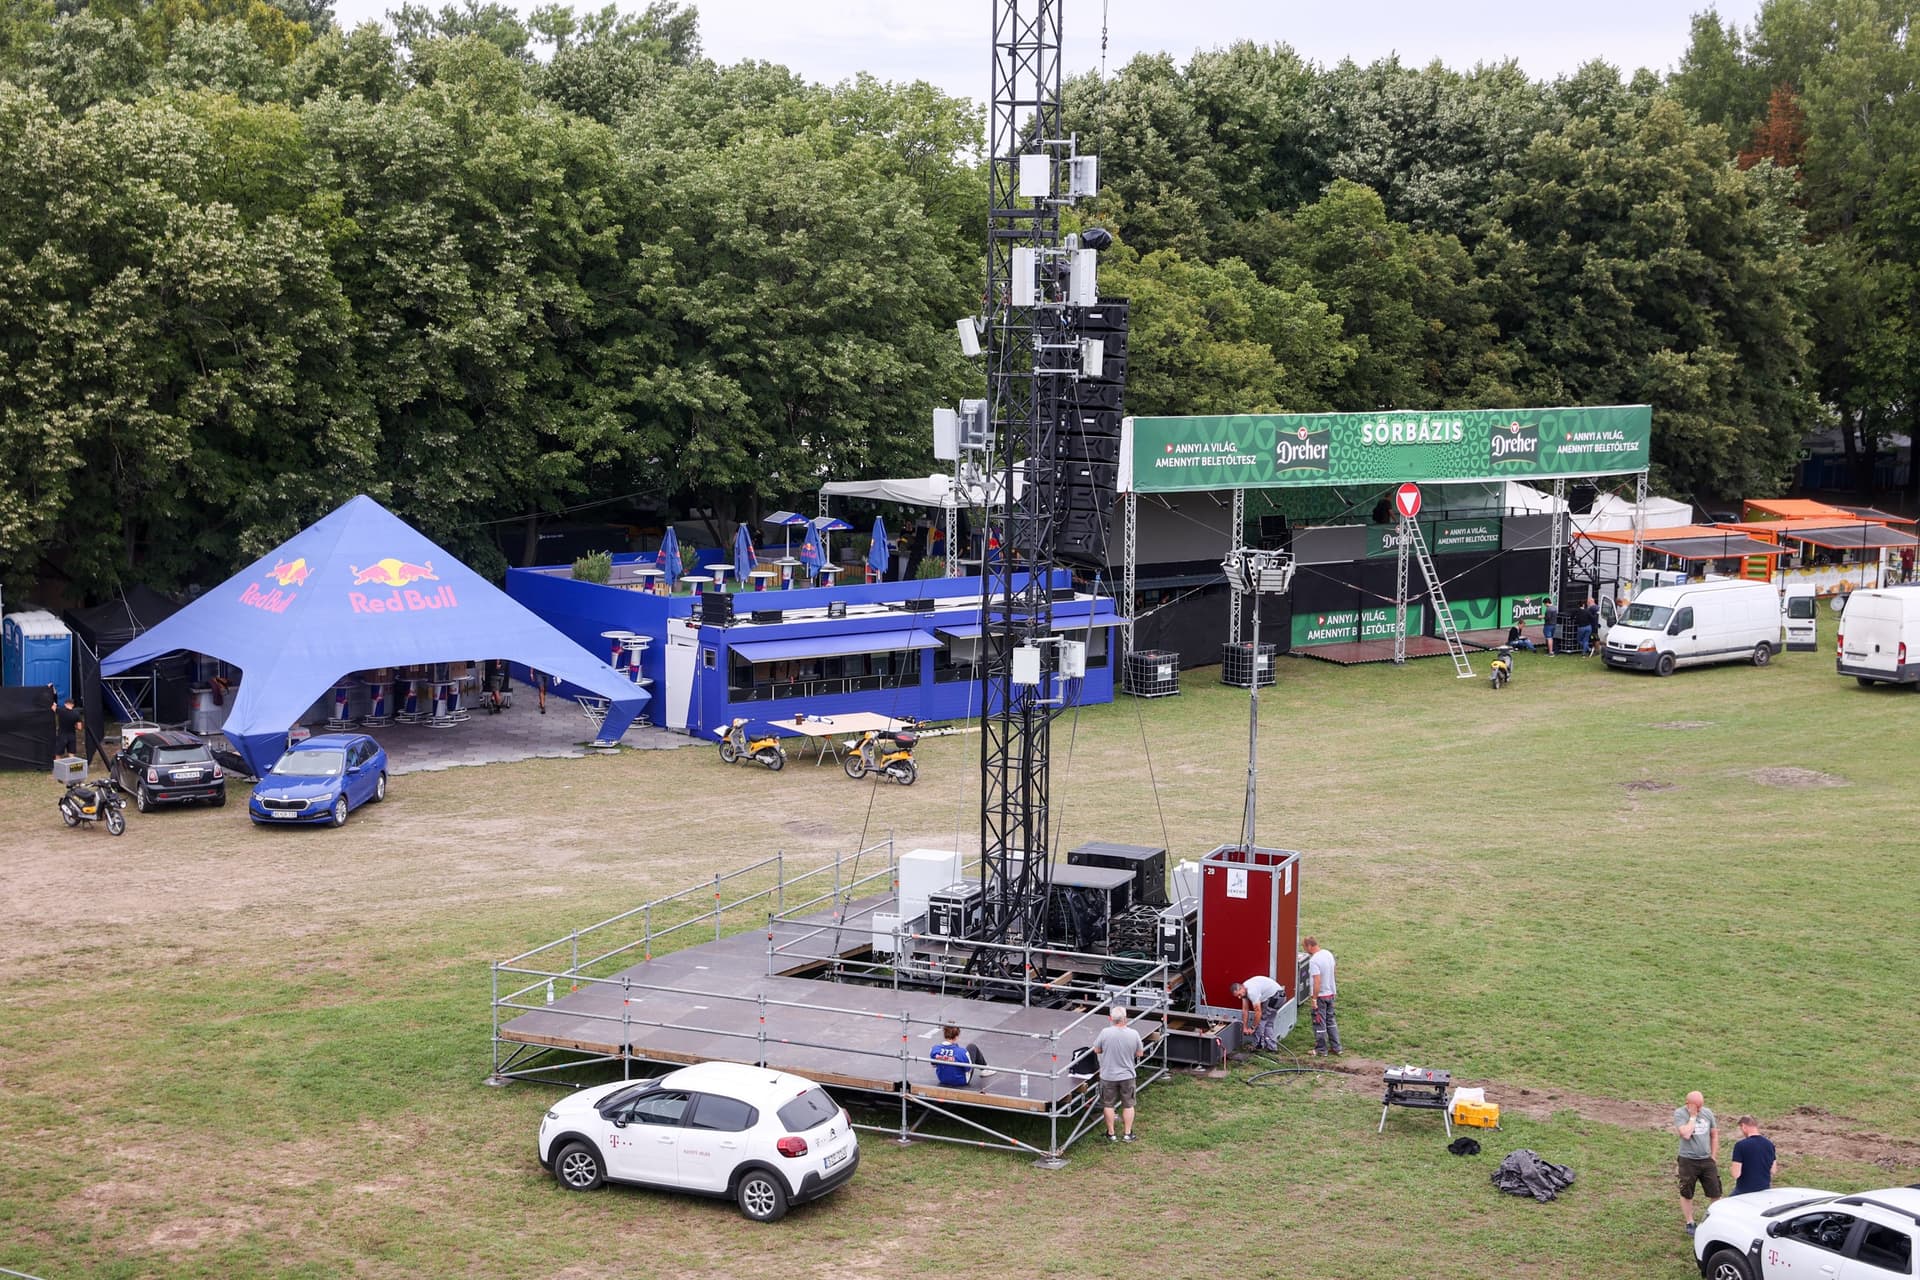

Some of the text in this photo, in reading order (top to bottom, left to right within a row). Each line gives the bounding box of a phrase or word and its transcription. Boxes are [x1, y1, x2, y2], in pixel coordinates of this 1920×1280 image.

[1573, 429, 1625, 442] ANNYI A VILÁG,
[1175, 441, 1238, 454] ANNYI A VILÁG,
[1276, 438, 1328, 465] Dreher
[1491, 432, 1538, 457] Dreher
[1557, 442, 1640, 454] AMENNYIT BELETÖLTESZ
[1155, 455, 1257, 468] AMENNYIT BELETÖLTESZ
[1450, 528, 1467, 536] ANNYI
[1438, 537, 1465, 545] AMENNYIT
[239, 582, 297, 614] Red Bull
[349, 585, 458, 614] Red Bull
[1327, 615, 1353, 625] ANNYI
[1361, 610, 1387, 622] VILÁG,
[1512, 603, 1542, 619] Dreher
[1307, 622, 1405, 640] AMENNYIT BLETÖLTEZ
[940, 1048, 954, 1056] 273
